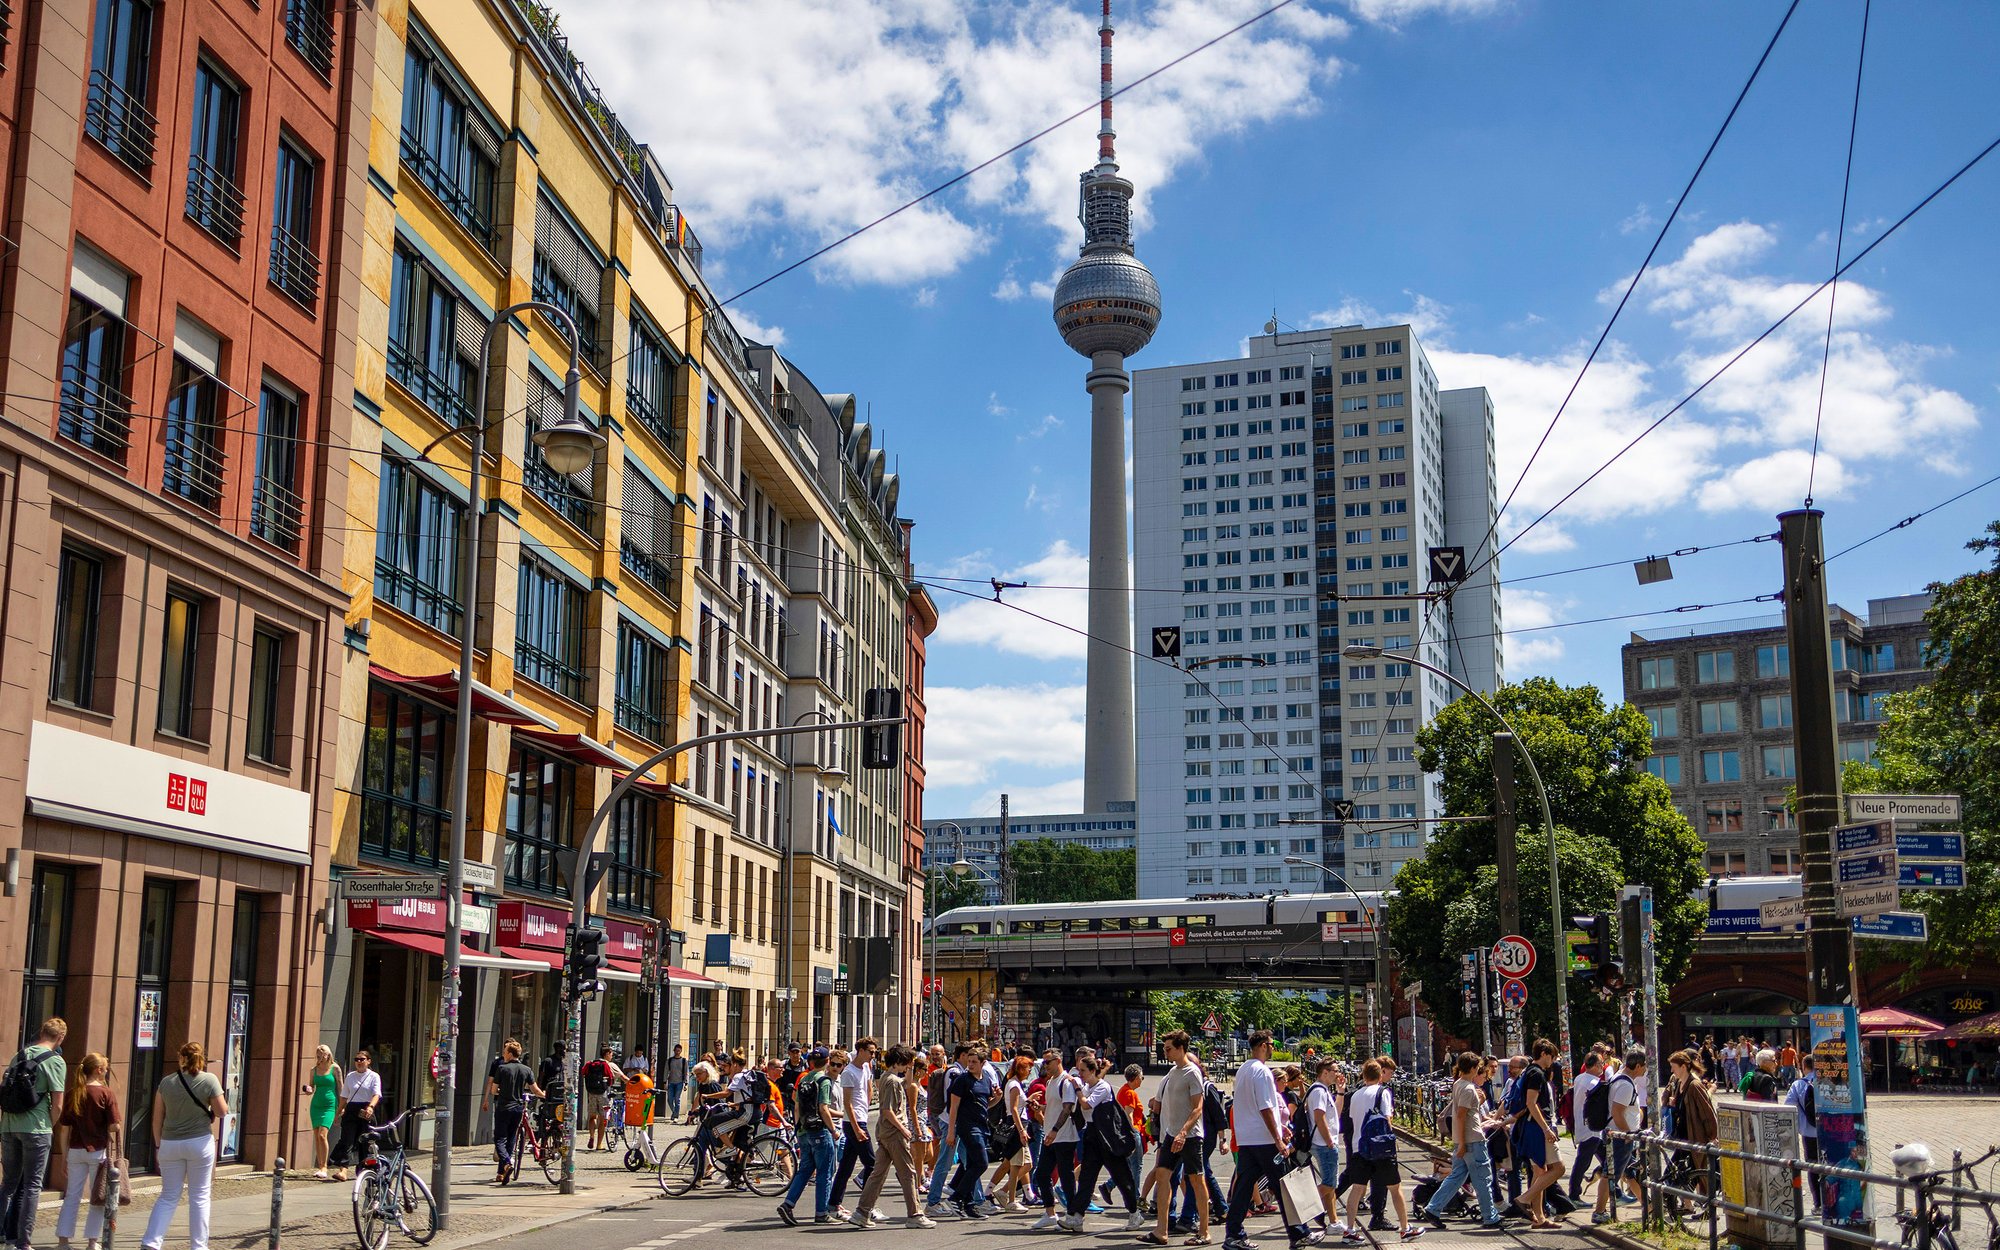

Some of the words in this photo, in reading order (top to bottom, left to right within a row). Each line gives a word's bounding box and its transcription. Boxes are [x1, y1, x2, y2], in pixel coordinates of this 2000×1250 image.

[171, 778, 184, 792] ユニ
[192, 784, 204, 798] UNI
[169, 793, 184, 806] クロ
[191, 797, 204, 811] QLO
[1856, 801, 1885, 813] Neue
[1889, 801, 1951, 814] Promenade
[350, 880, 403, 892] Rosenthaler
[405, 880, 434, 894] Straße
[1844, 894, 1875, 908] Hackescher
[1876, 891, 1892, 904] Markt
[1795, 903, 1804, 913] Ma
[500, 918, 518, 927] MUJI
[527, 914, 545, 936] MUJI
[623, 931, 637, 950] MUJI
[1503, 946, 1526, 966] 30
[1952, 998, 1983, 1010] BBQ
[1695, 1016, 1702, 1025] S
[1791, 1016, 1798, 1025] S
